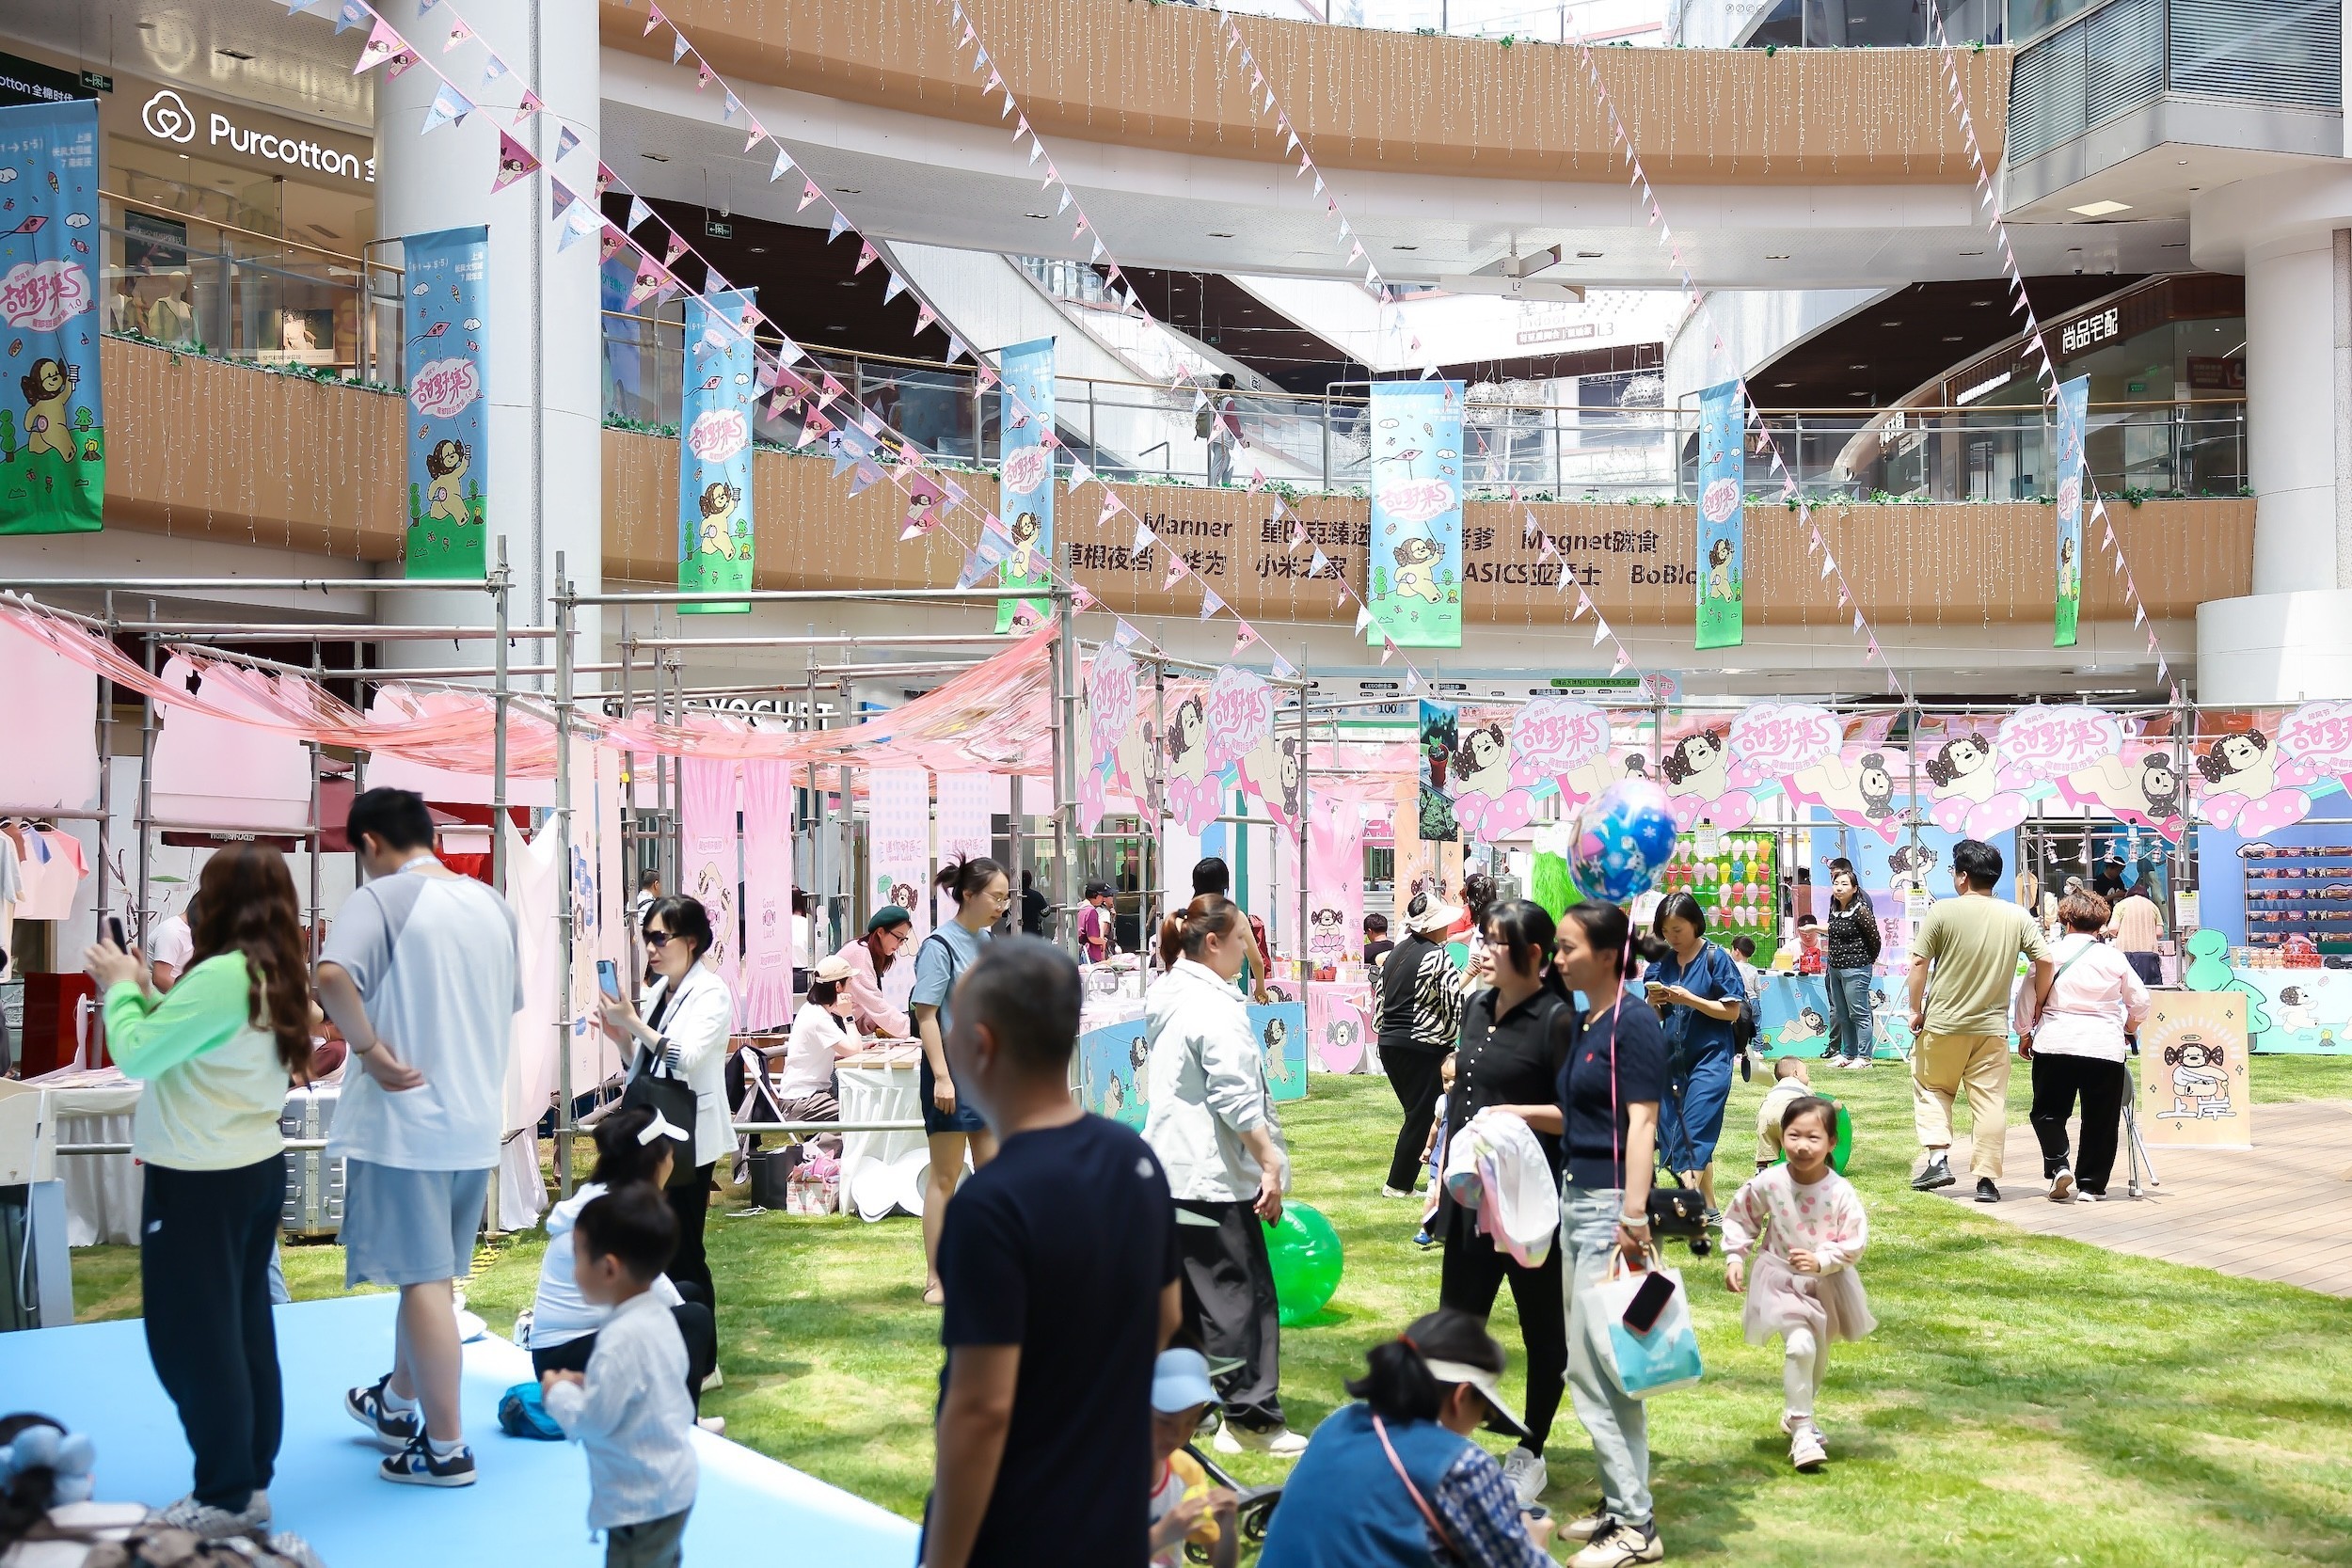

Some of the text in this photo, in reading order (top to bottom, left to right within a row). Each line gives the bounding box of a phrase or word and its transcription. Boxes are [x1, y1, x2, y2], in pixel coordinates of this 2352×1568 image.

[210, 112, 359, 180] Purcotton
[1597, 323, 1614, 337] L3
[2062, 307, 2118, 355] 尚品宅配
[1144, 513, 1233, 539] Manner
[1183, 550, 1227, 576] 华为
[1256, 556, 1347, 580] 小米之家
[1588, 744, 1600, 755] 1.0
[1818, 745, 1831, 756] 1.0
[2044, 746, 2109, 771] 魔都甜品市集 1.0
[2155, 1095, 2237, 1121] 上岸
